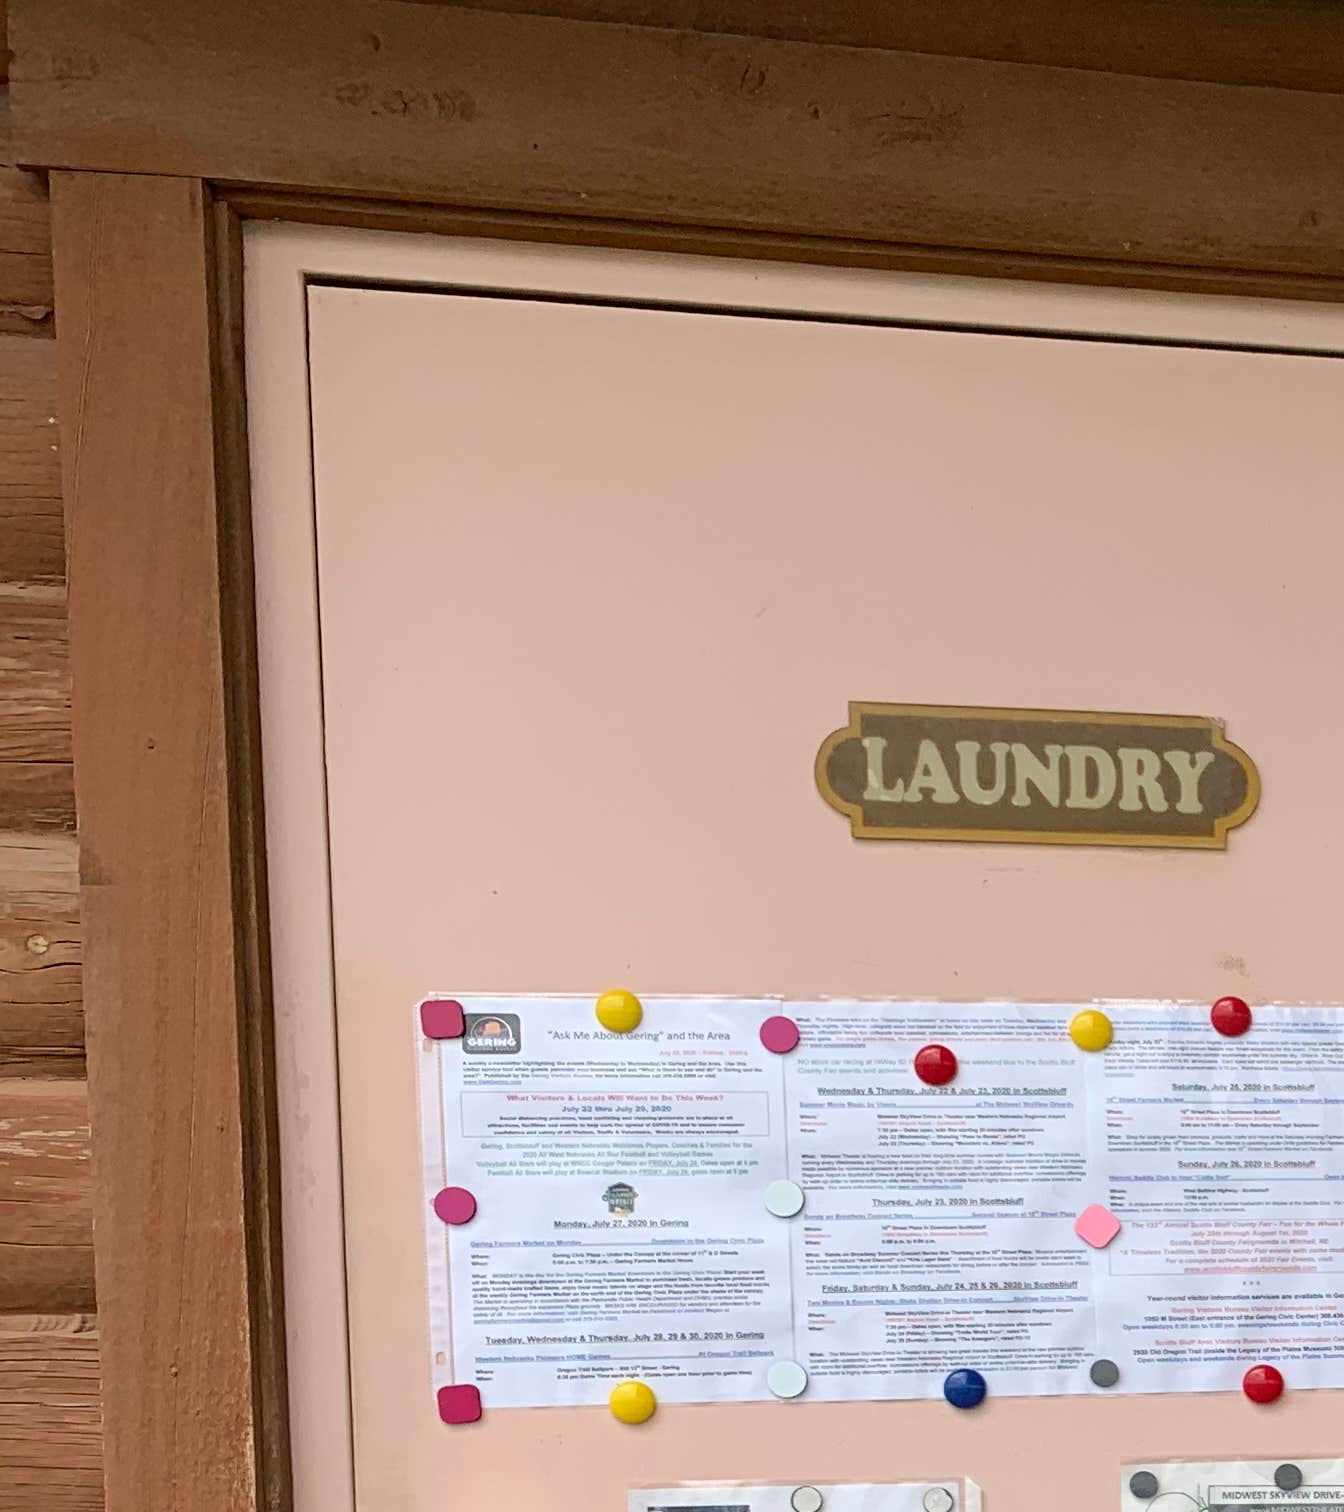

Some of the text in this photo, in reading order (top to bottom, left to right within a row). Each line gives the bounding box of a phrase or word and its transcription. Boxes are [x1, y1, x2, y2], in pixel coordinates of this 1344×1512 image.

[861, 736, 1215, 814] LAUNDRY
[573, 1032, 590, 1040] Me
[667, 1031, 685, 1040] and
[688, 1031, 705, 1040] the
[708, 1031, 730, 1040] Area
[467, 1038, 517, 1047] GERING
[1222, 1491, 1268, 1499] MIDWEST
